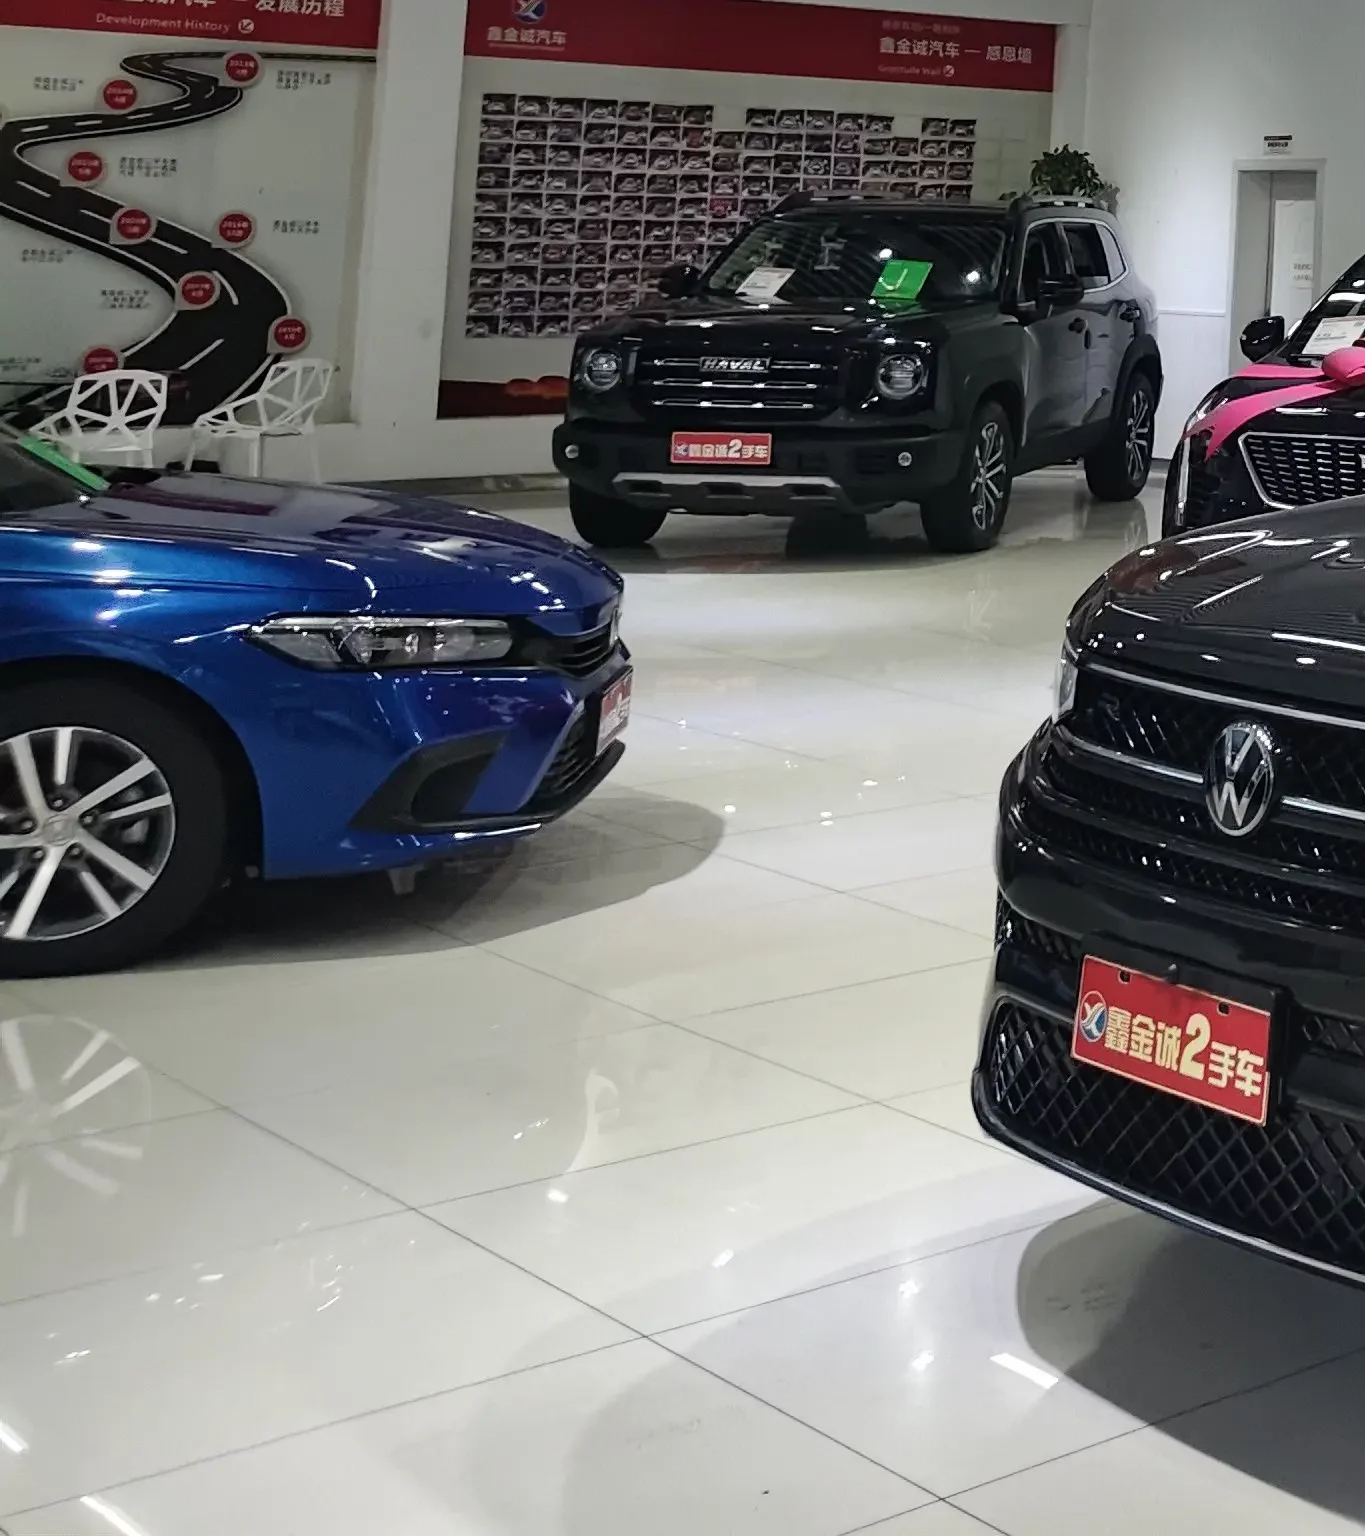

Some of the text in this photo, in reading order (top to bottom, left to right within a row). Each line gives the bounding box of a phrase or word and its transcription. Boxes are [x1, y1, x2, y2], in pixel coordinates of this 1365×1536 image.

[96, 13, 230, 34] Development History
[880, 36, 960, 59] 鑫金诚汽车
[703, 359, 765, 370] HAVAL
[688, 439, 768, 459] 鑫金诚2手车
[1104, 1006, 1264, 1097] 鑫金诚2手车
